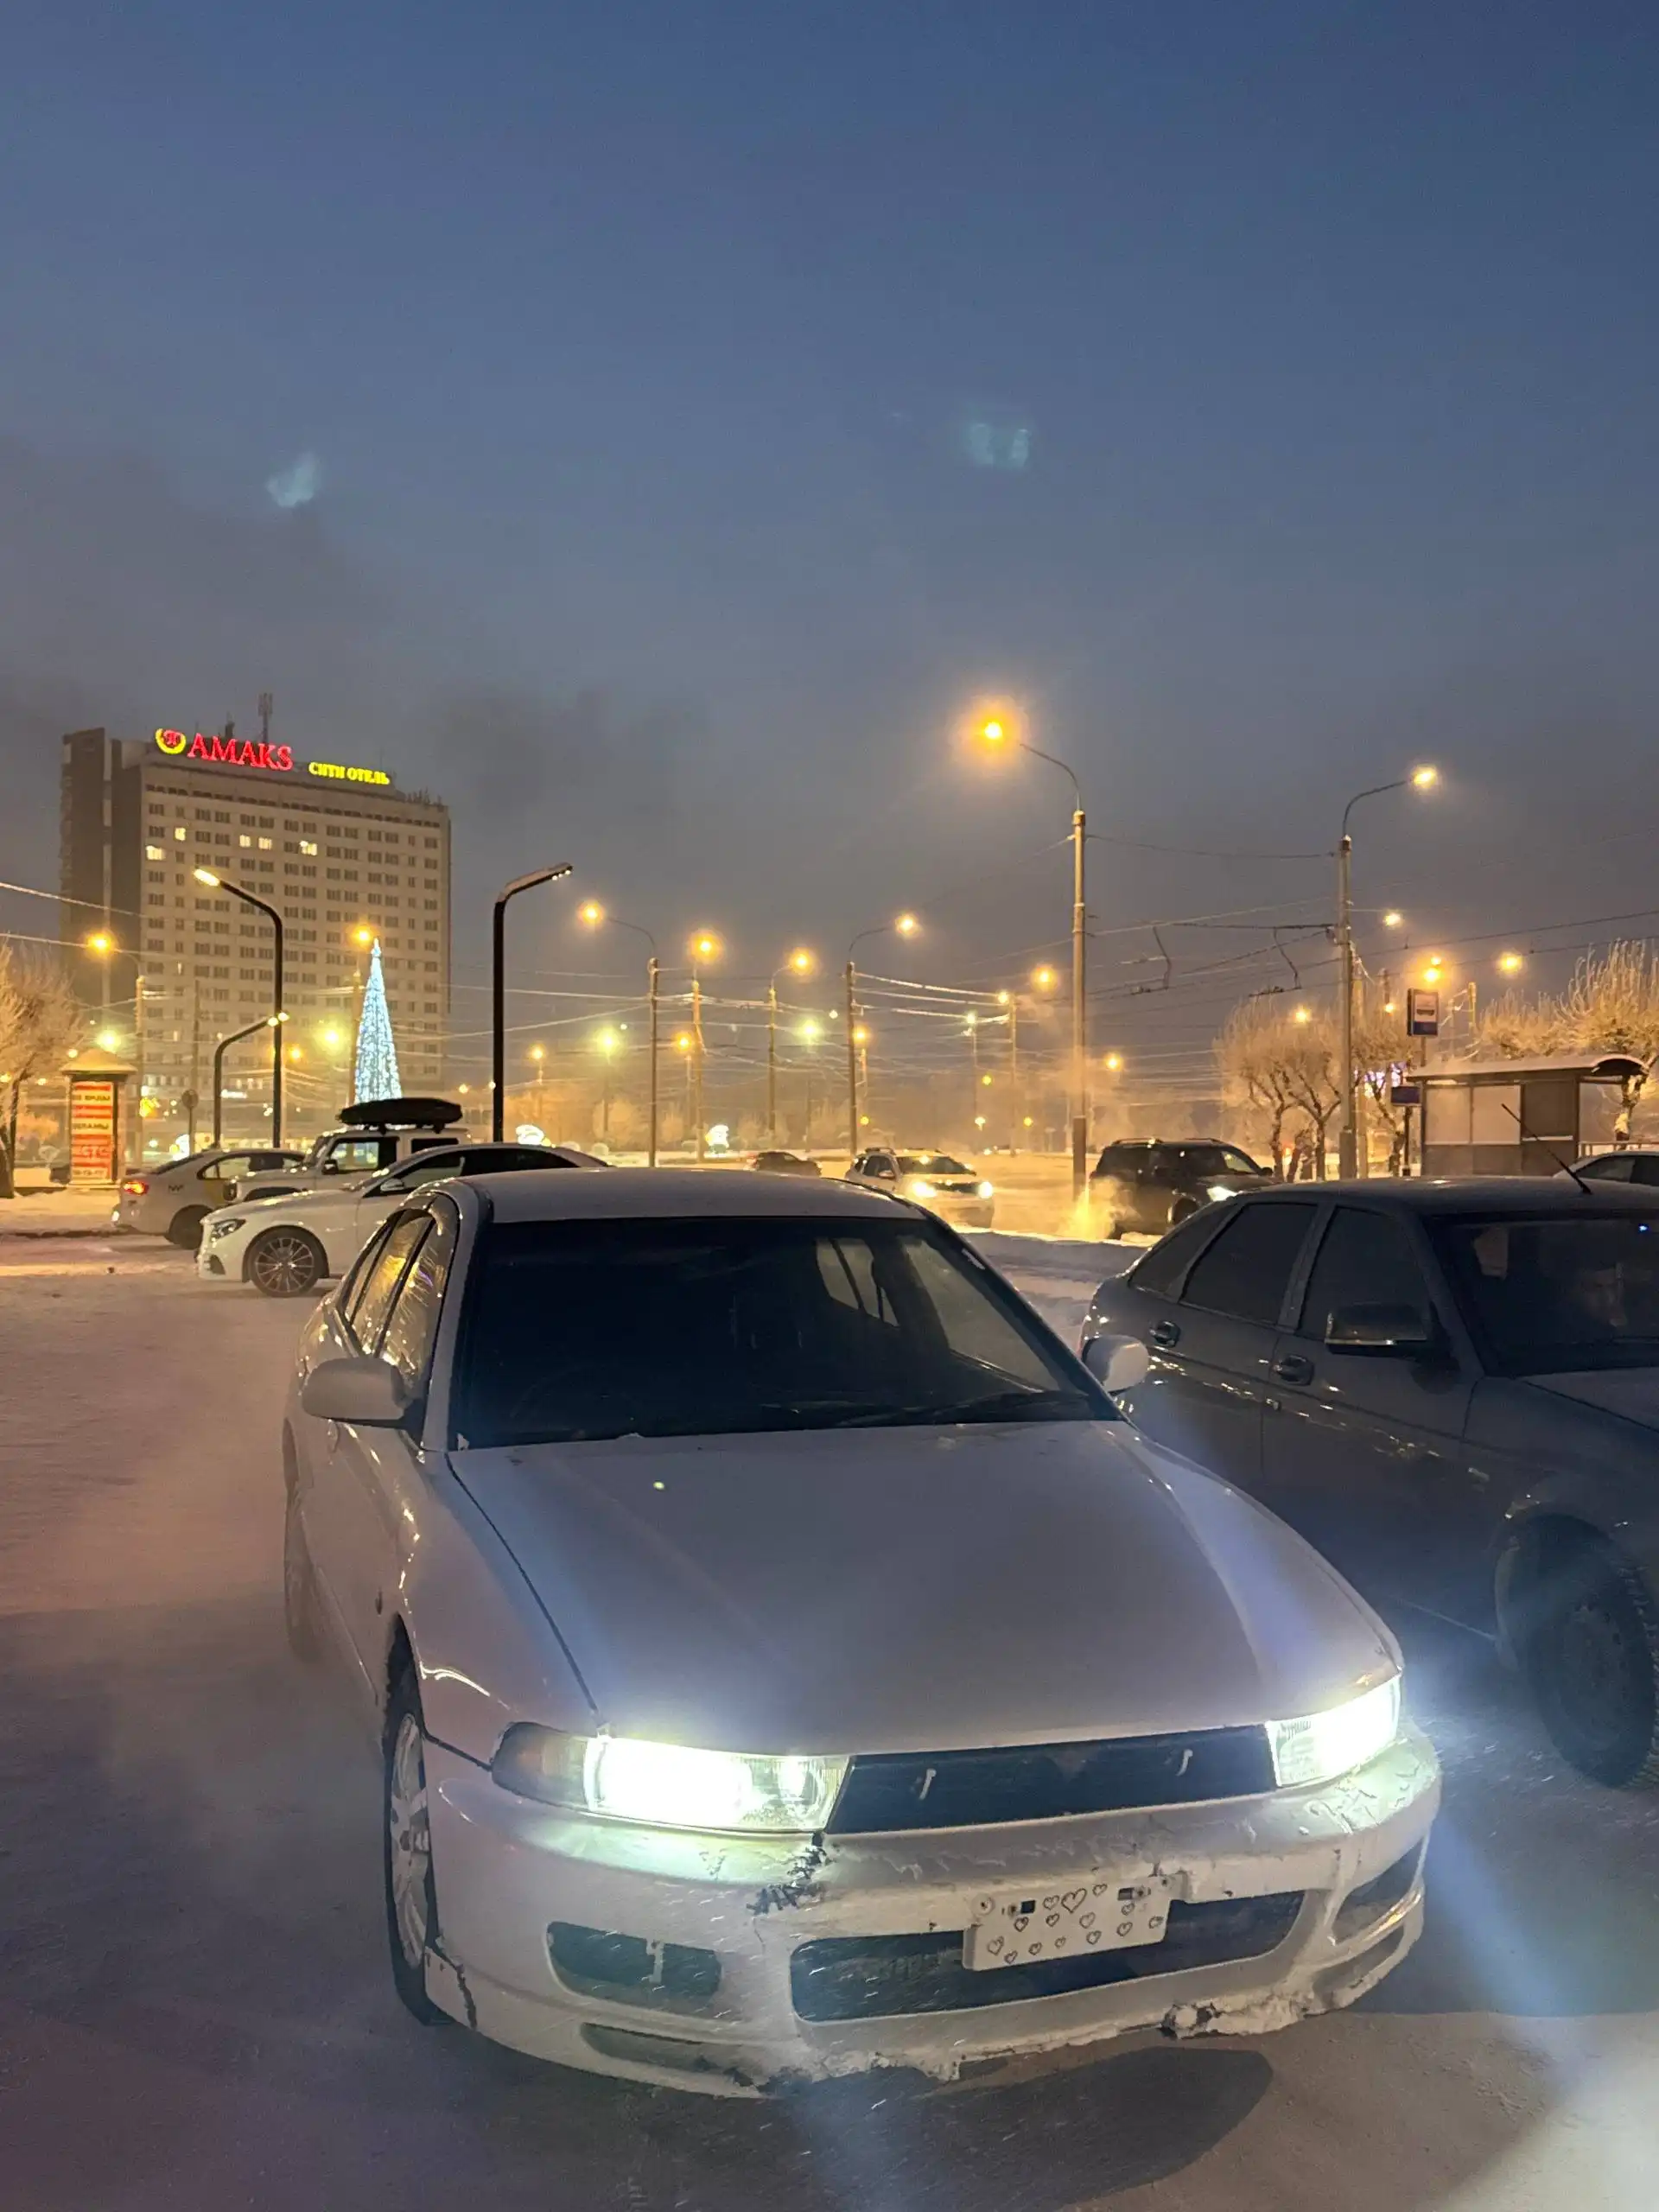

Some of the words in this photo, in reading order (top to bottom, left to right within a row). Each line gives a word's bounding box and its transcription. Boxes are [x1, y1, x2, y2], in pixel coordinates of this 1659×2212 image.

[187, 733, 294, 771] AMAKS
[308, 761, 346, 779] СИТИ
[346, 766, 391, 785] ОТЕЛЬ
